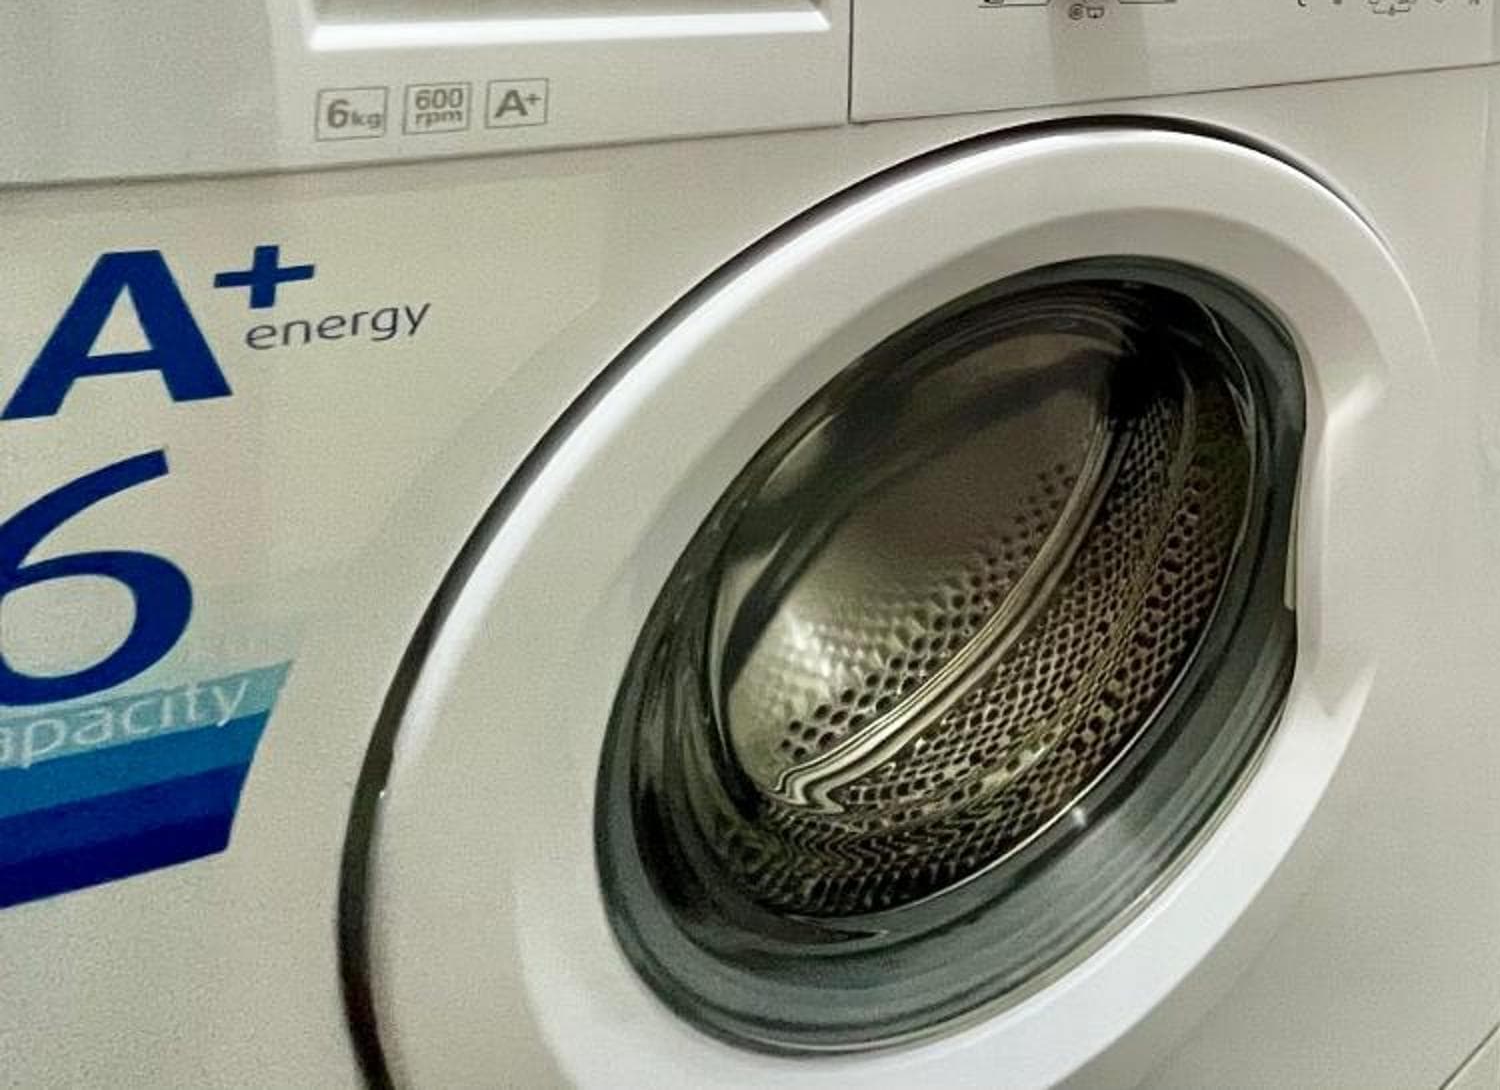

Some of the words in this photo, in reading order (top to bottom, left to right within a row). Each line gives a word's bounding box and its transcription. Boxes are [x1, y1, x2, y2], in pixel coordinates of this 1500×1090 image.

[415, 87, 464, 110] 600
[495, 89, 542, 118] A+
[415, 110, 463, 127] rpm
[245, 302, 431, 350] energy
